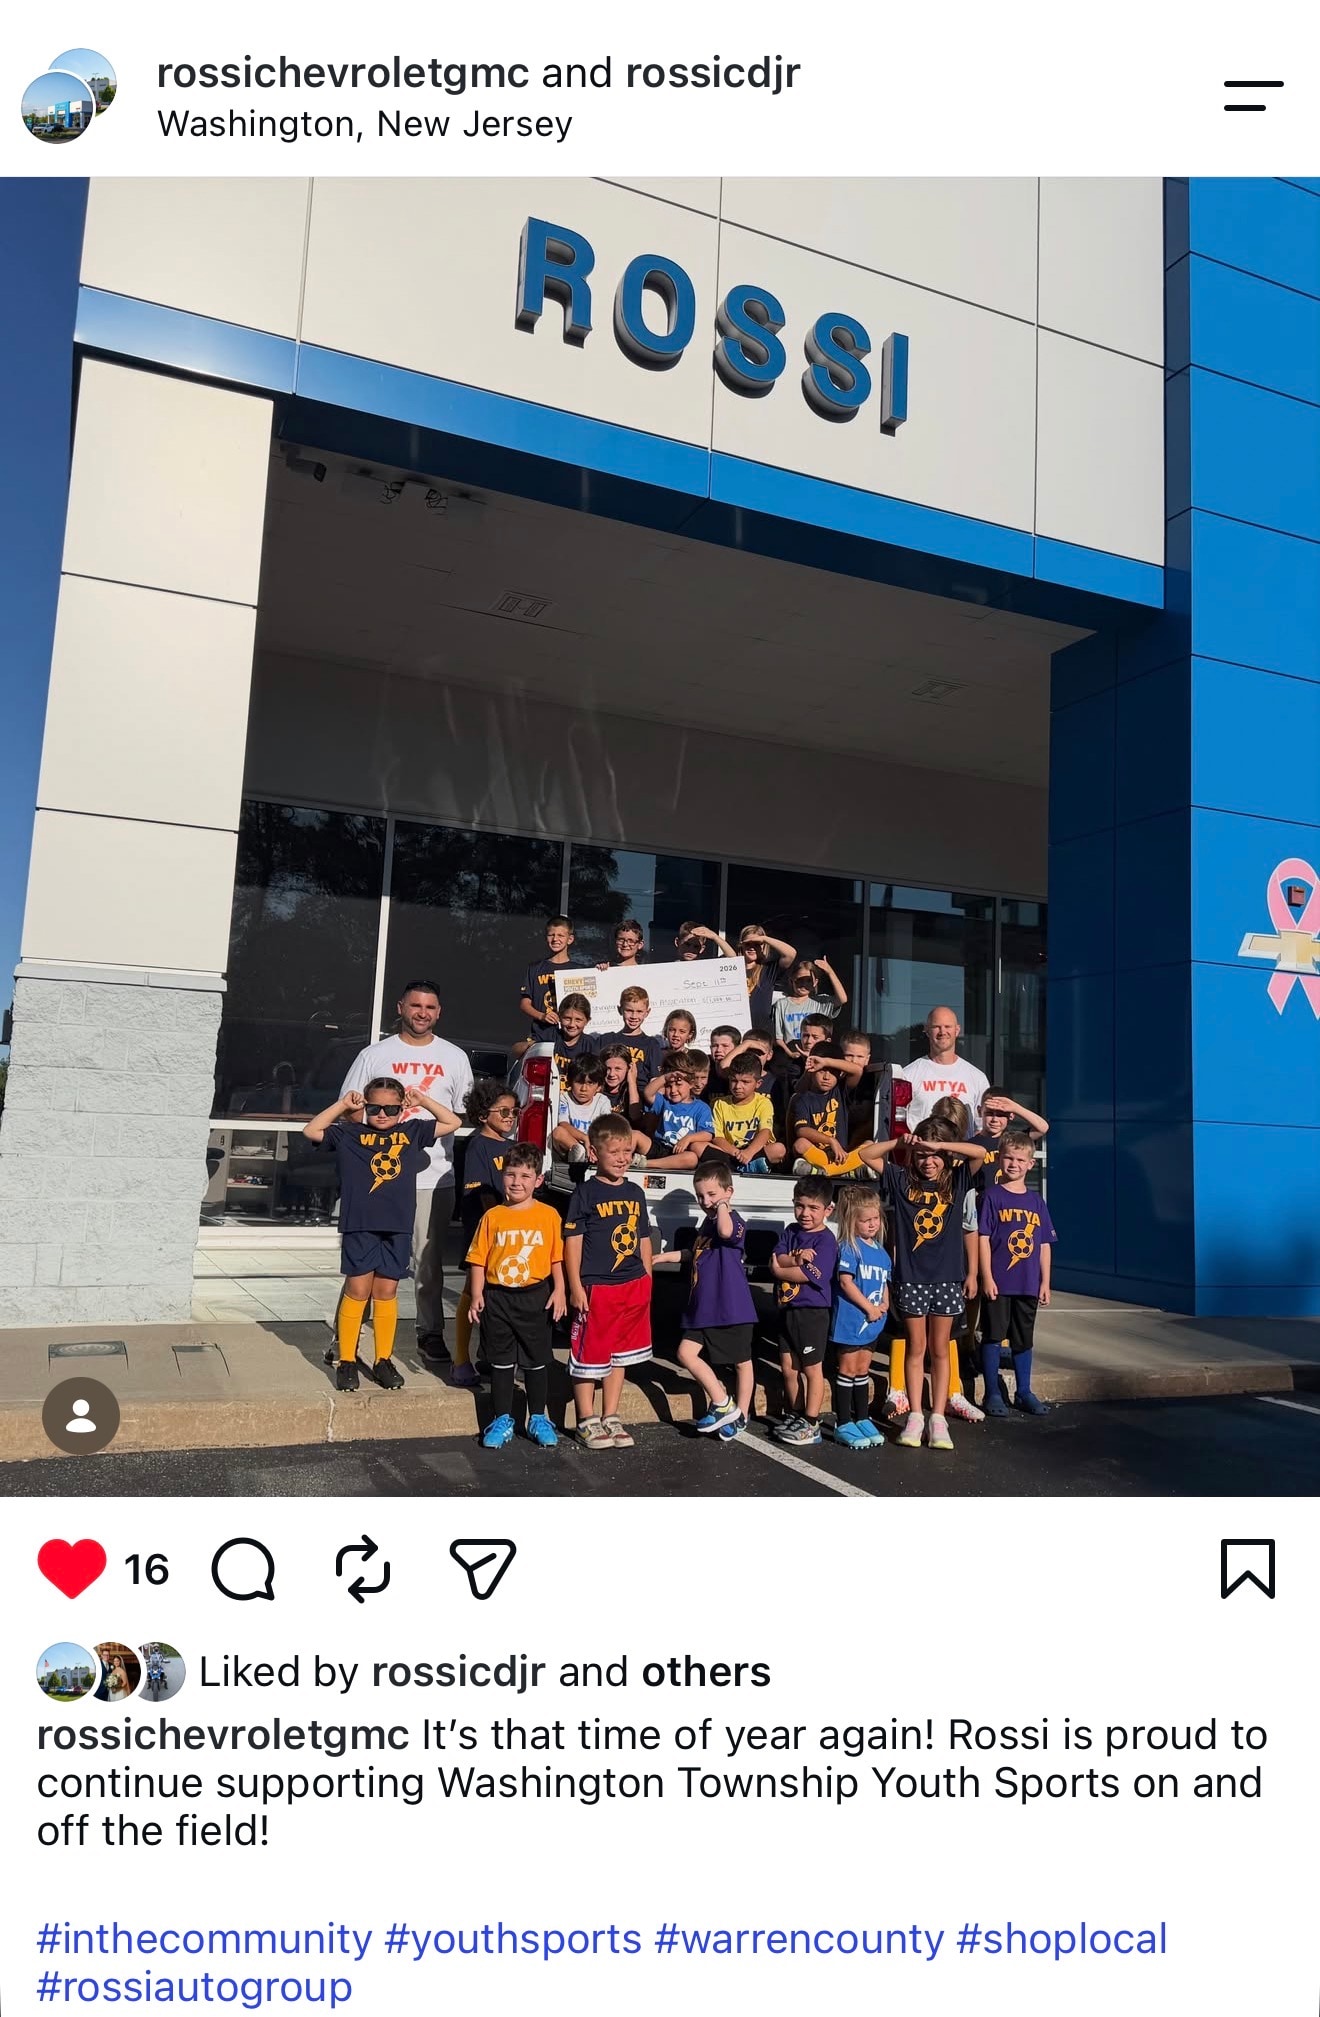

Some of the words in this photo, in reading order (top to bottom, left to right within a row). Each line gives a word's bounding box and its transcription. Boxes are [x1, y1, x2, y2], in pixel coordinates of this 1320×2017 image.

[516, 216, 909, 434] ROSSI
[391, 1062, 445, 1077] WTYA
[923, 1080, 968, 1094] WTYA
[725, 1117, 760, 1132] WTYA
[360, 1131, 411, 1146] WTYA
[595, 1200, 641, 1218] WTYA
[998, 1208, 1041, 1227] WTYA
